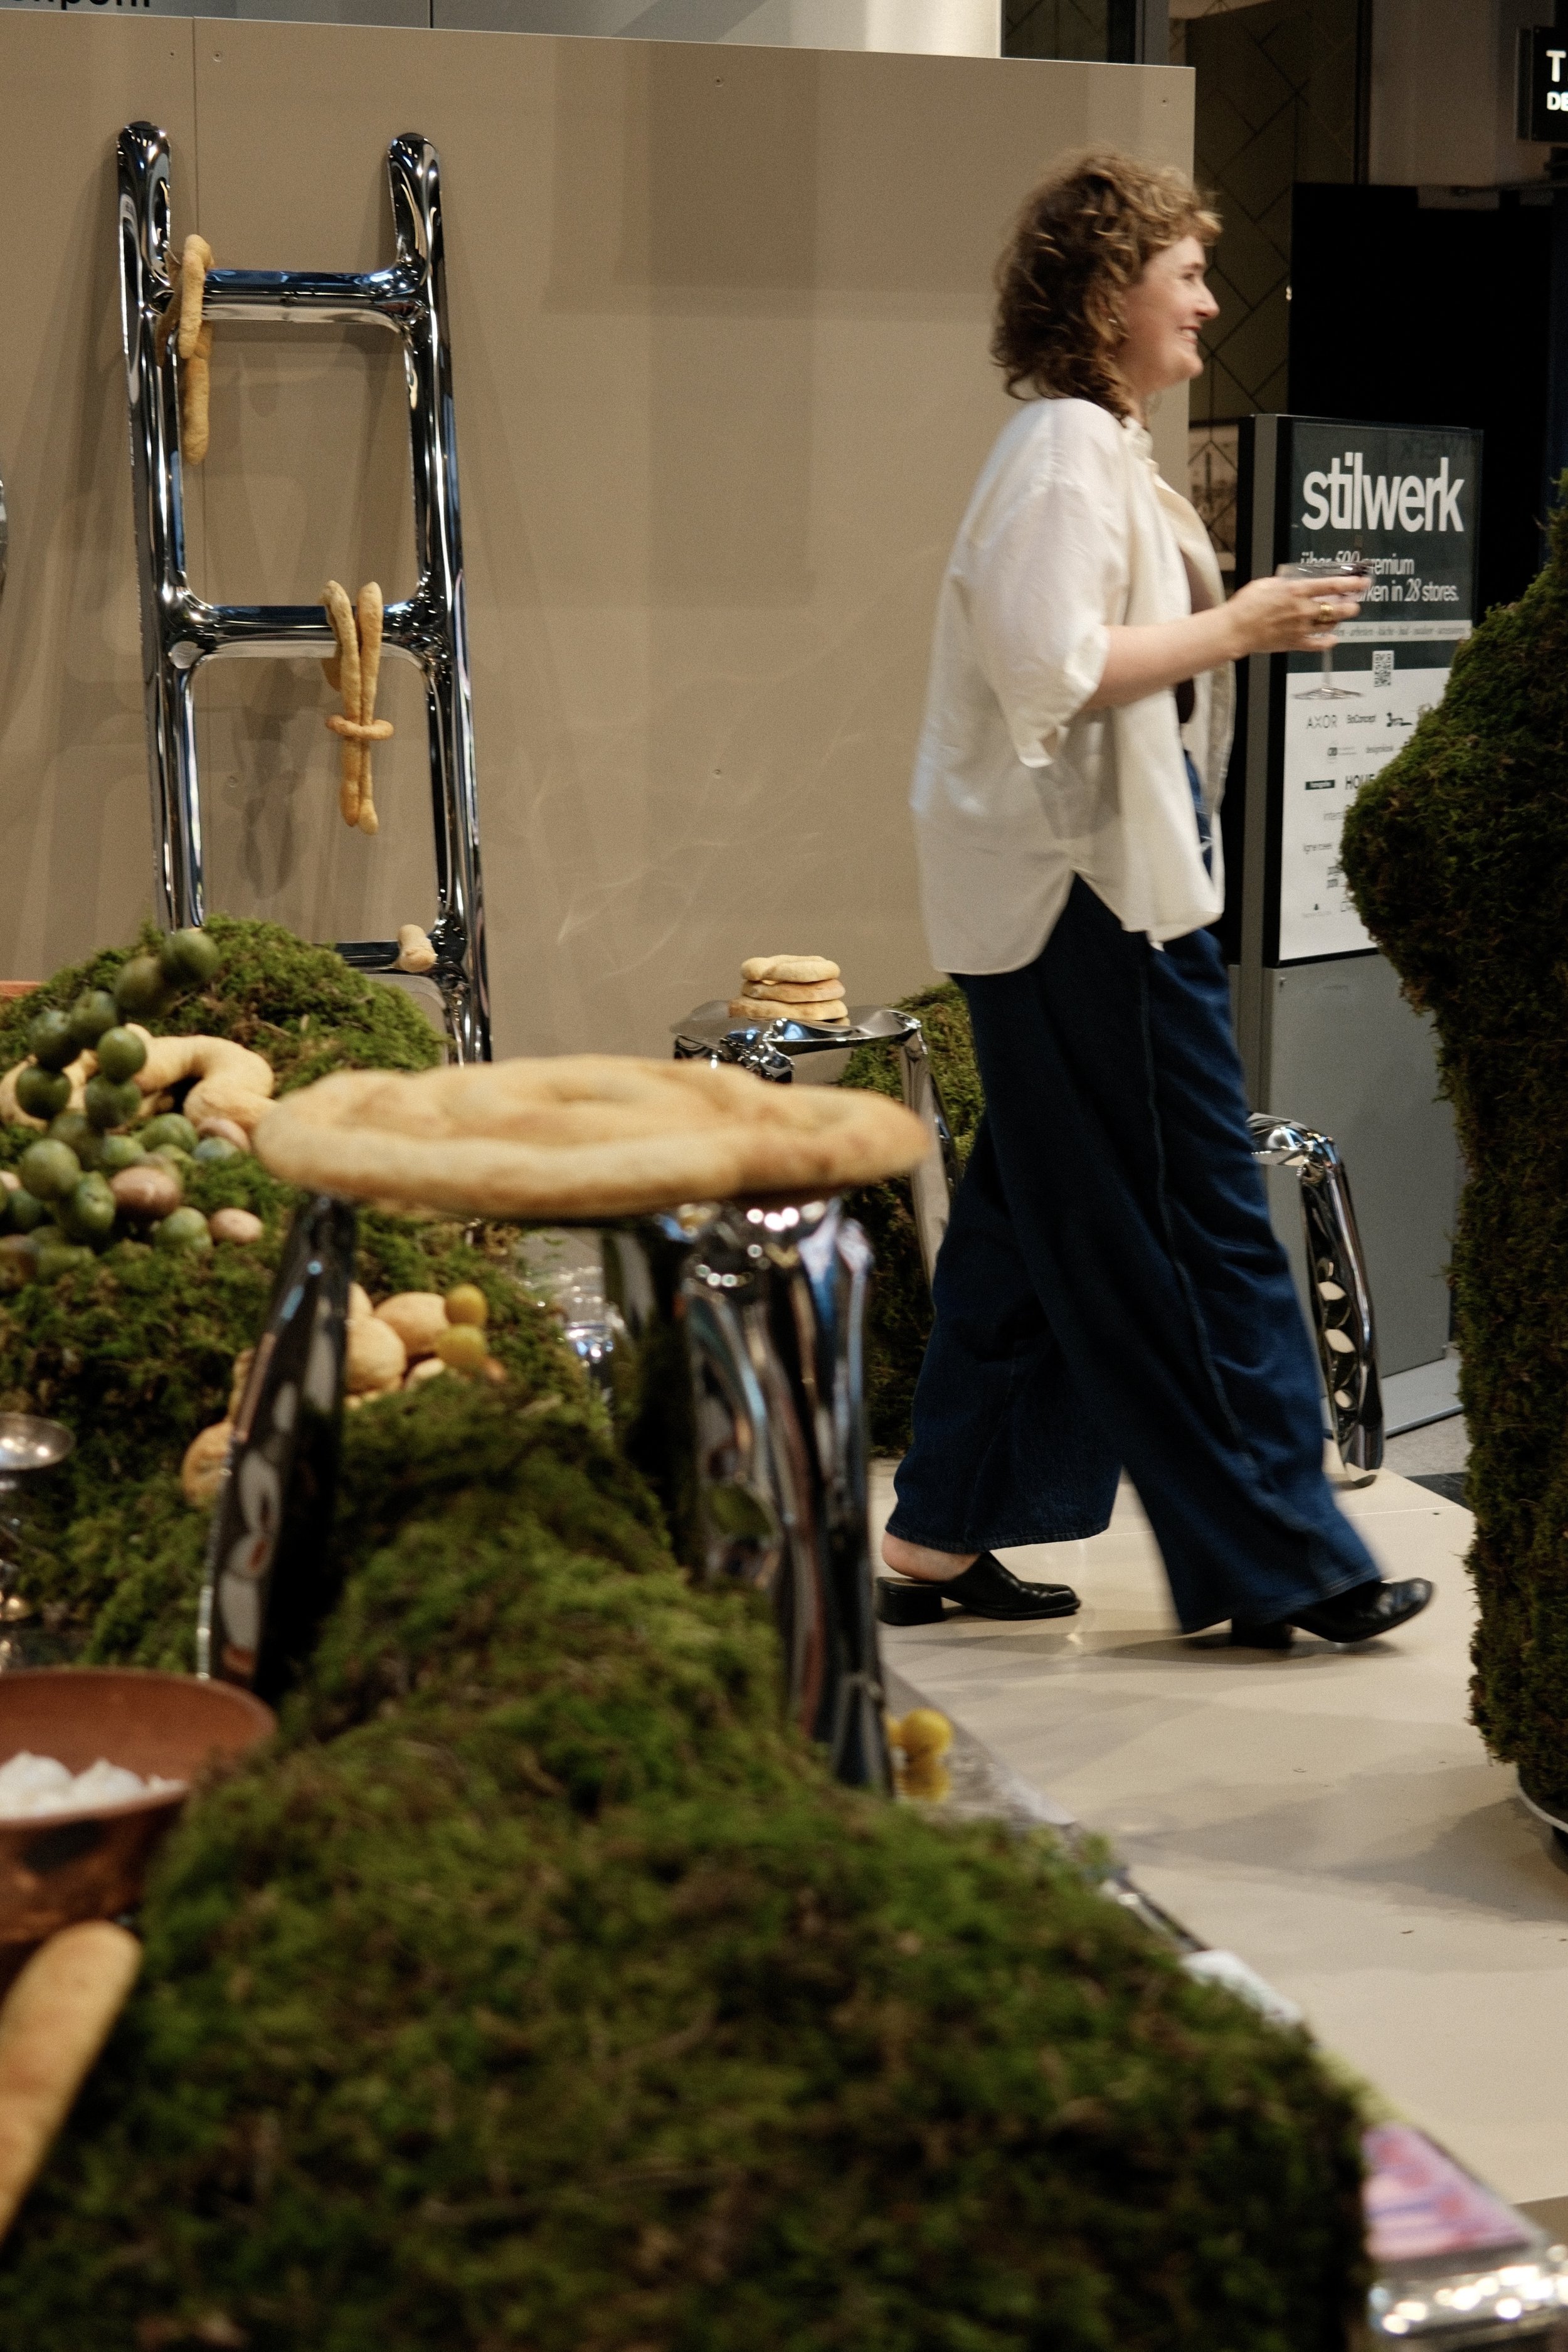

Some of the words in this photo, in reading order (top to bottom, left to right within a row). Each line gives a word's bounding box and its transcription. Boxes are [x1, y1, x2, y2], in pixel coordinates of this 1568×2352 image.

[1546, 50, 1568, 82] T
[1301, 452, 1465, 532] stilwerk
[1391, 580, 1403, 601] in
[1404, 578, 1421, 602] 28
[1306, 714, 1337, 729] AXOR
